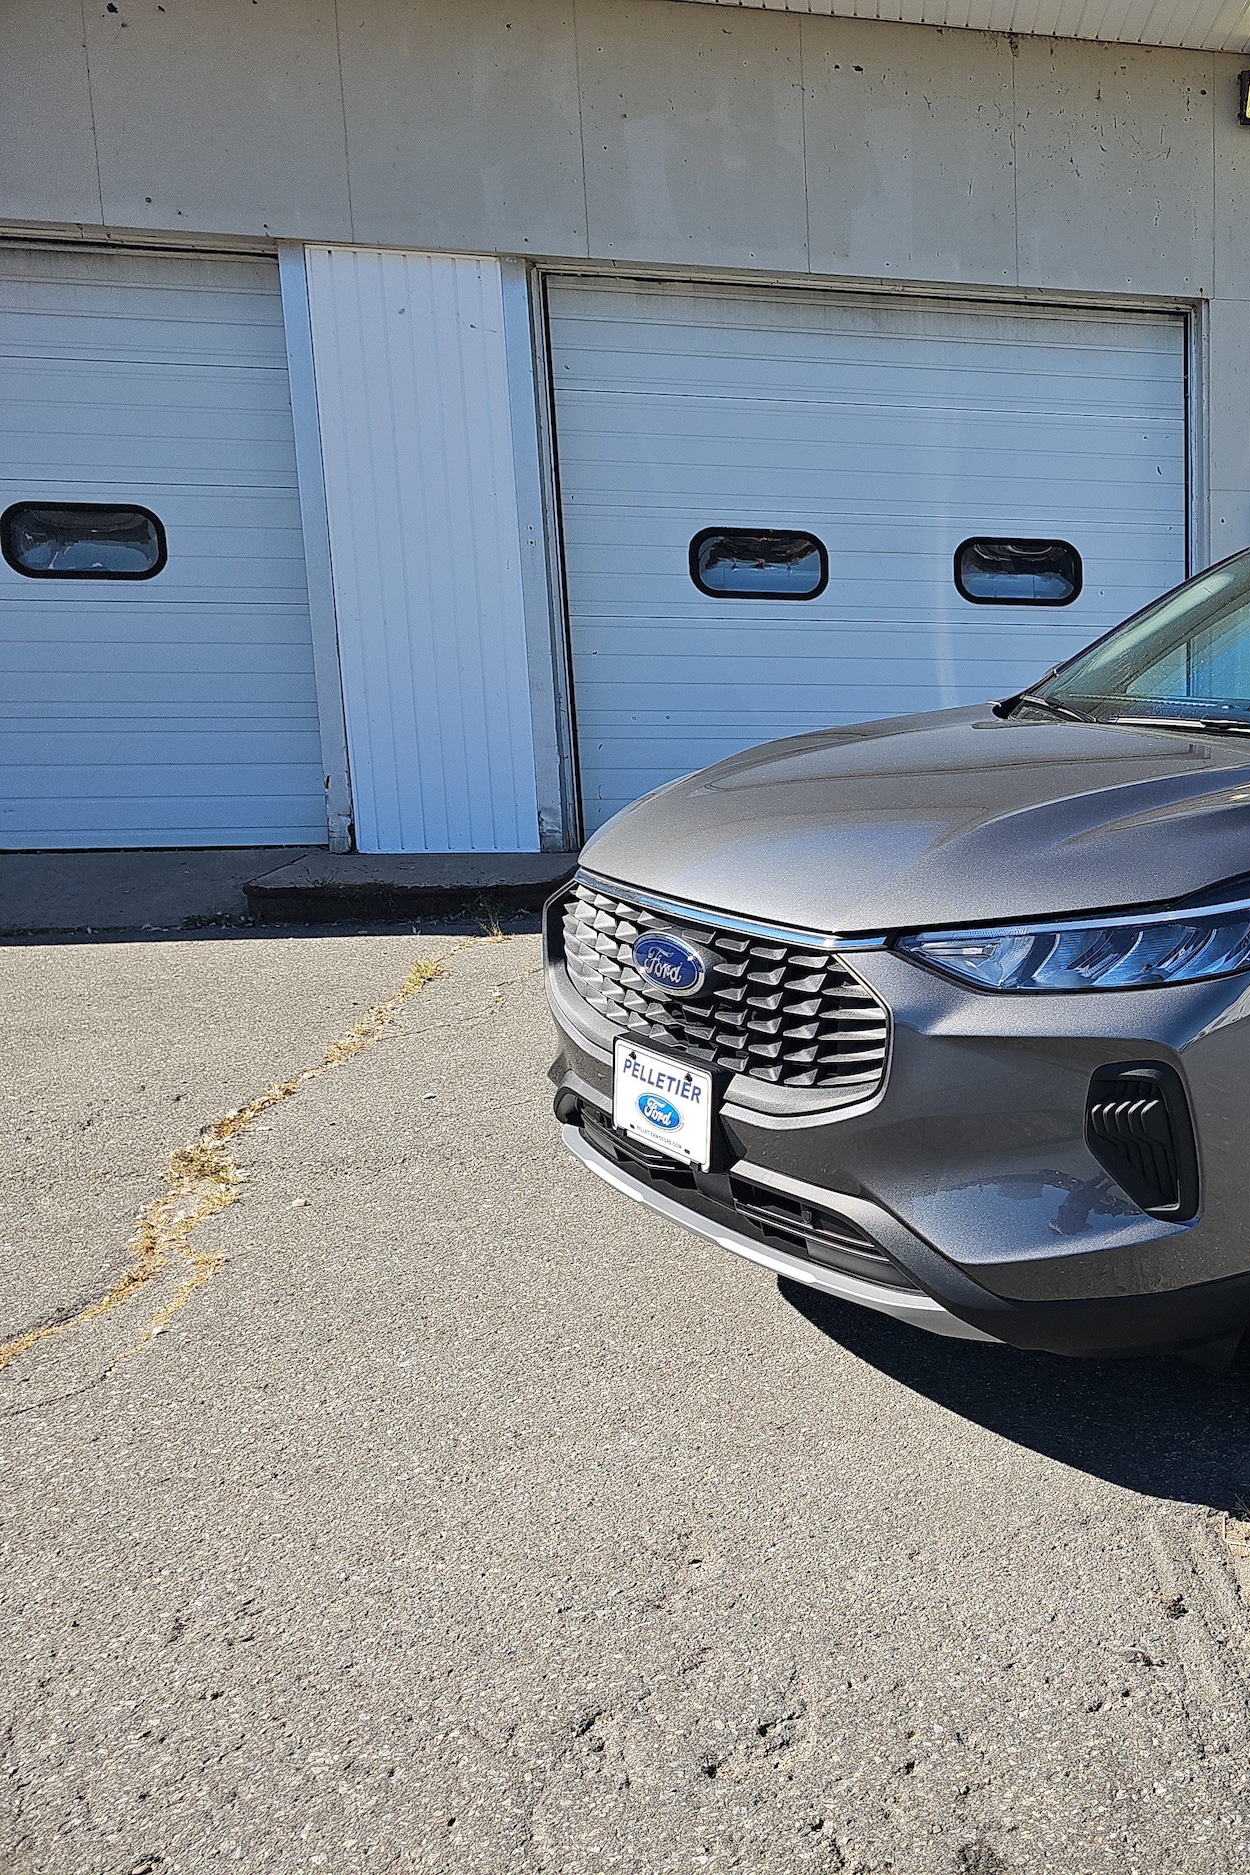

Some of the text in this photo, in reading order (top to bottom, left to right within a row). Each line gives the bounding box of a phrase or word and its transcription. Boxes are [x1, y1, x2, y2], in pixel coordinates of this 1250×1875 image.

[643, 945, 684, 984] Ford
[623, 1058, 702, 1104] PELLETIER
[643, 1097, 673, 1126] Ford
